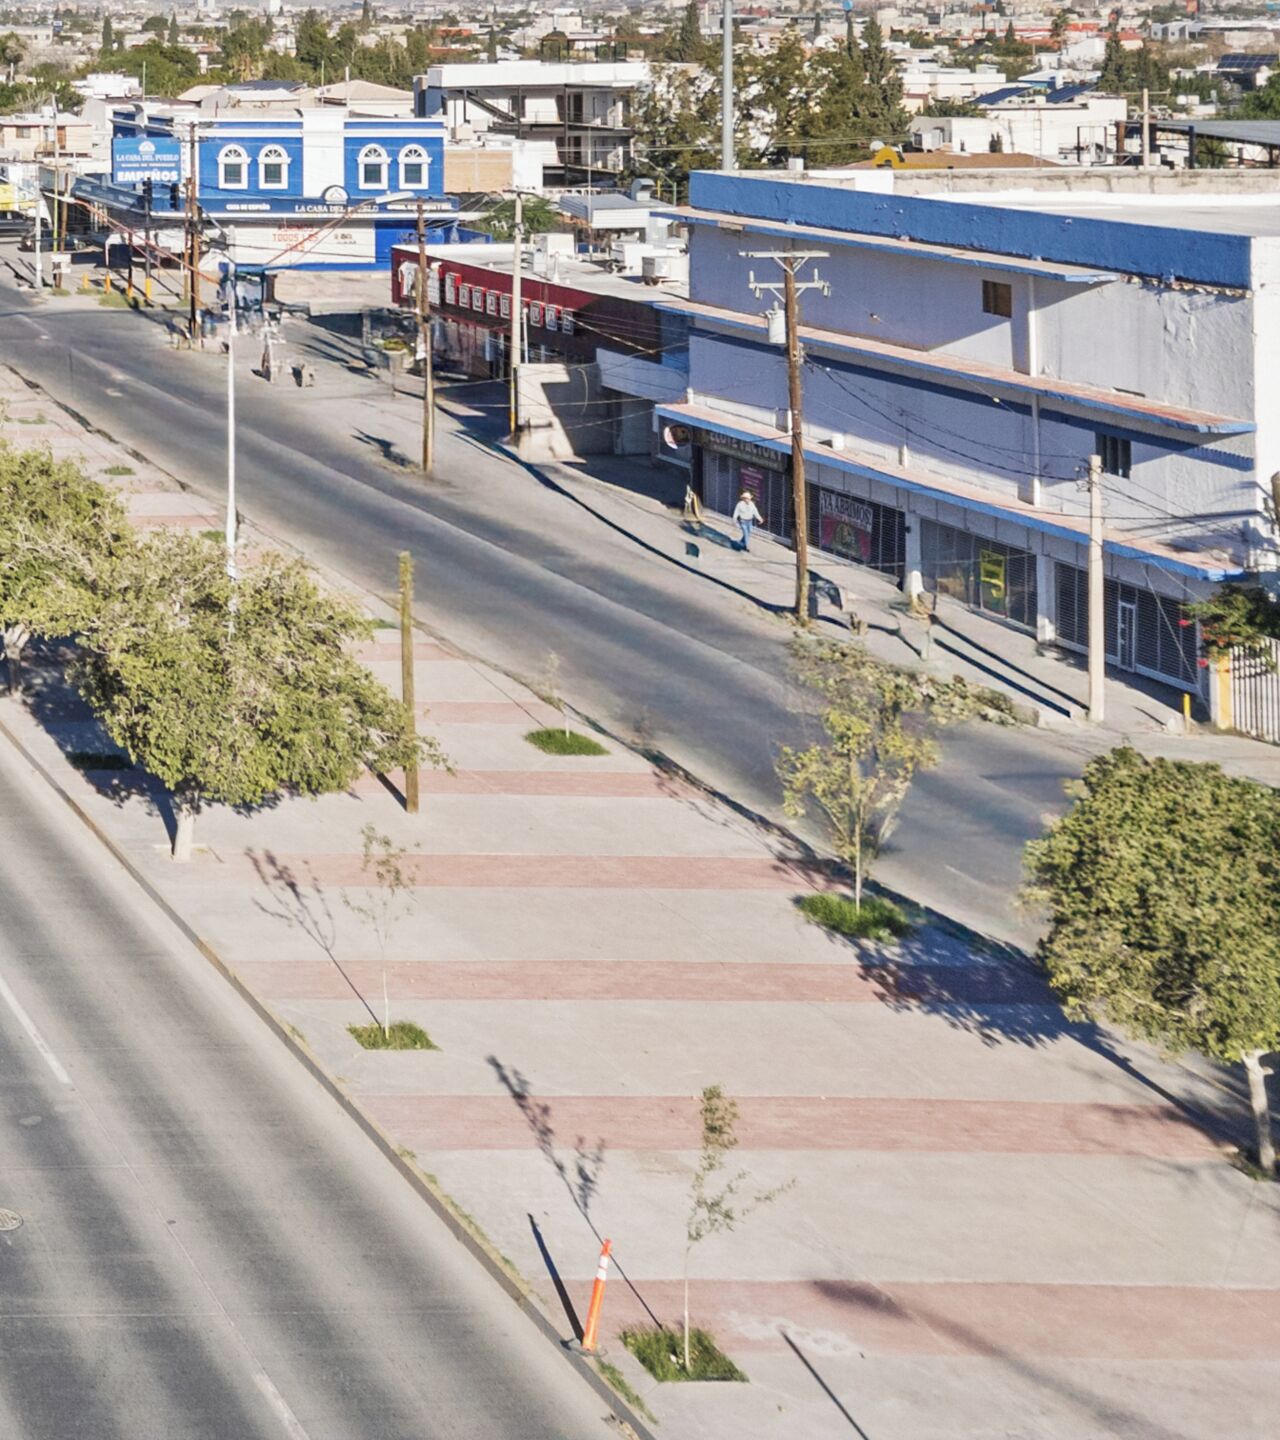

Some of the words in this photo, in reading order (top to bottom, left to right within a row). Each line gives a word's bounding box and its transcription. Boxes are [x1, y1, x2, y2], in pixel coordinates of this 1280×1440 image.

[117, 168, 179, 182] EMPEÑOS
[295, 205, 306, 213] LA
[307, 205, 328, 213] CASA
[329, 205, 346, 213] DEL
